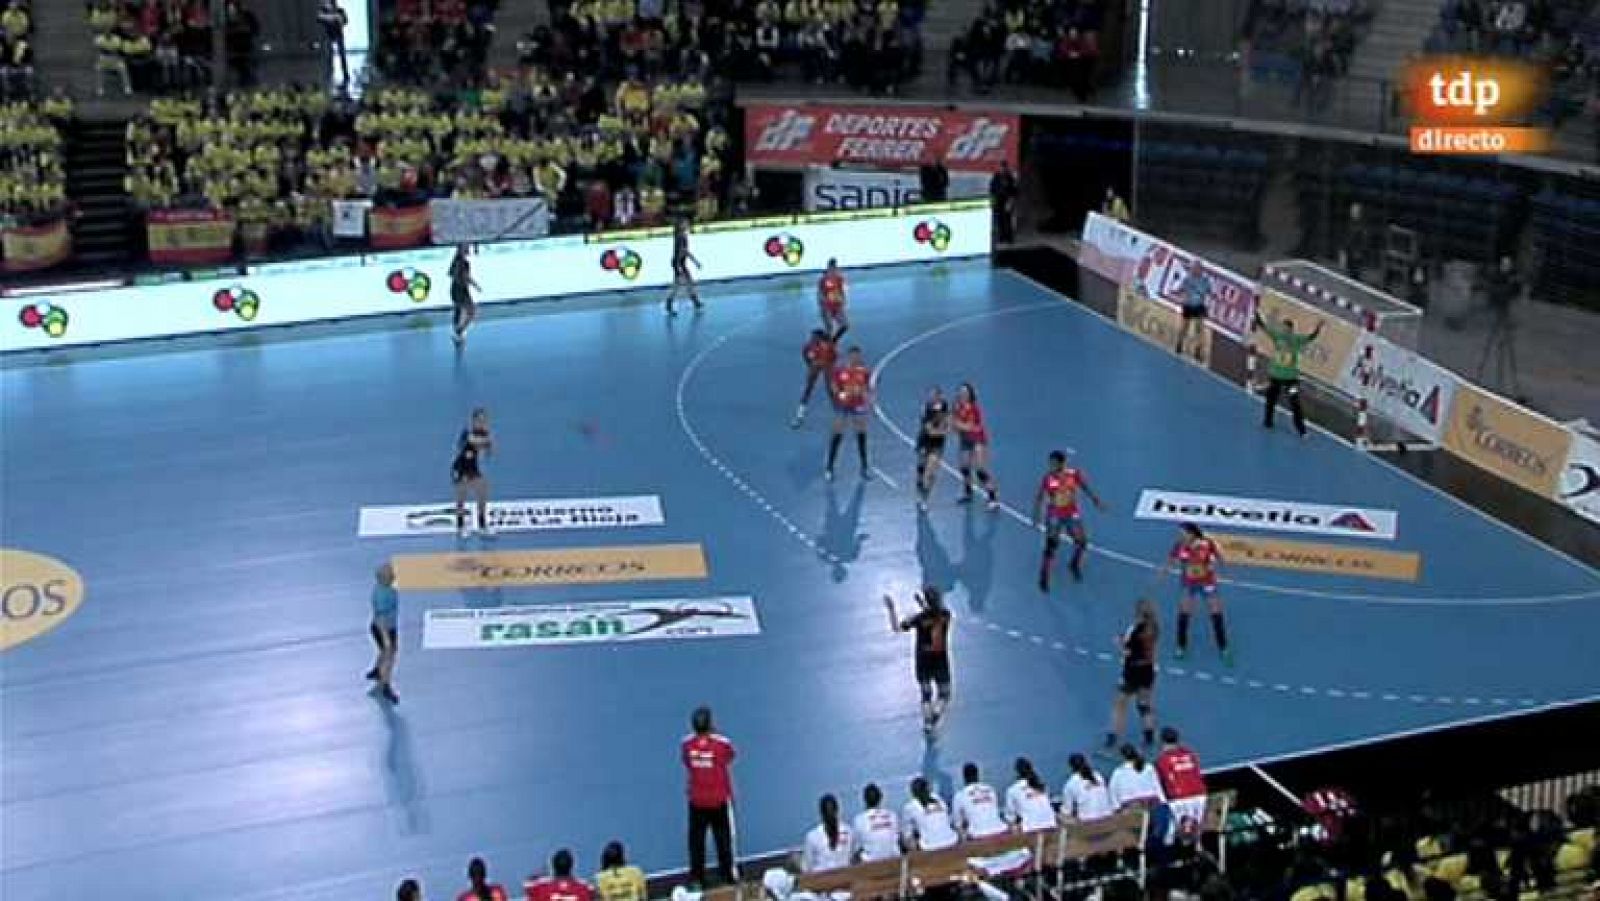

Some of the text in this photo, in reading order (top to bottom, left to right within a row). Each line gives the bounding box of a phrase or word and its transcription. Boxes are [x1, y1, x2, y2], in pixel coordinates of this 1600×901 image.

[825, 112, 943, 139] DEPORTES
[836, 136, 926, 160] FERRER
[570, 511, 640, 524] Rioja
[1152, 499, 1322, 526] helvetia
[478, 558, 648, 580] CORREOS
[1245, 549, 1376, 571] CORREOS
